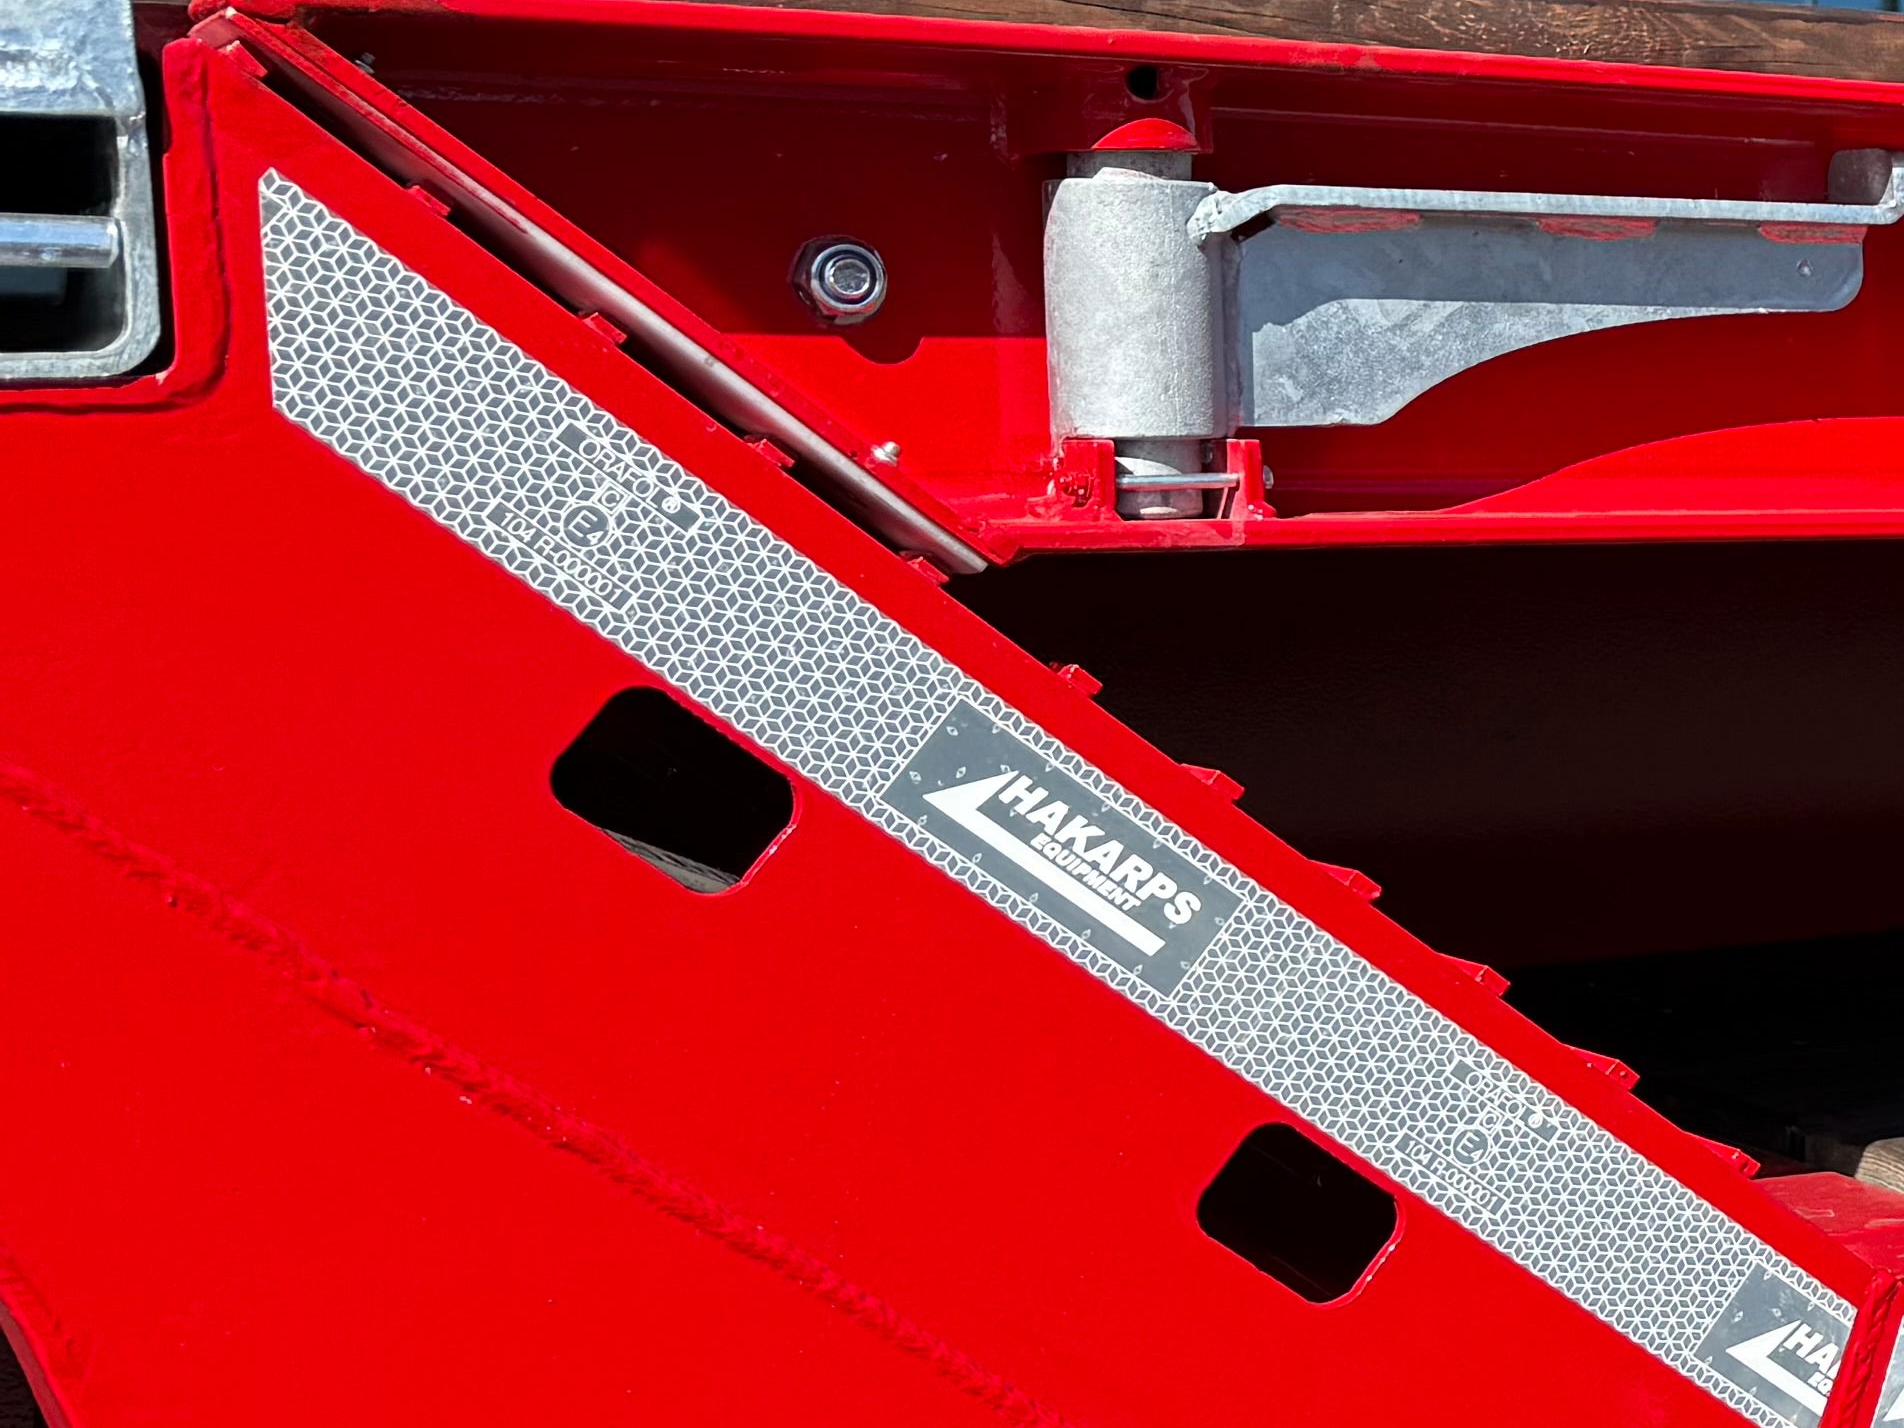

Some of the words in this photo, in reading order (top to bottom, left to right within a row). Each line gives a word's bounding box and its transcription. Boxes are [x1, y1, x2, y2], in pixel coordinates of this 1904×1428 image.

[500, 512, 537, 543] 104
[533, 535, 624, 603] R-000001
[998, 774, 1202, 925] HAKARPS
[1029, 834, 1143, 912] EQUIPMENT
[1405, 1140, 1433, 1165] 104
[1431, 1158, 1499, 1209] R-000001
[1782, 1322, 1841, 1382] HA
[1807, 1371, 1834, 1397] EQ
